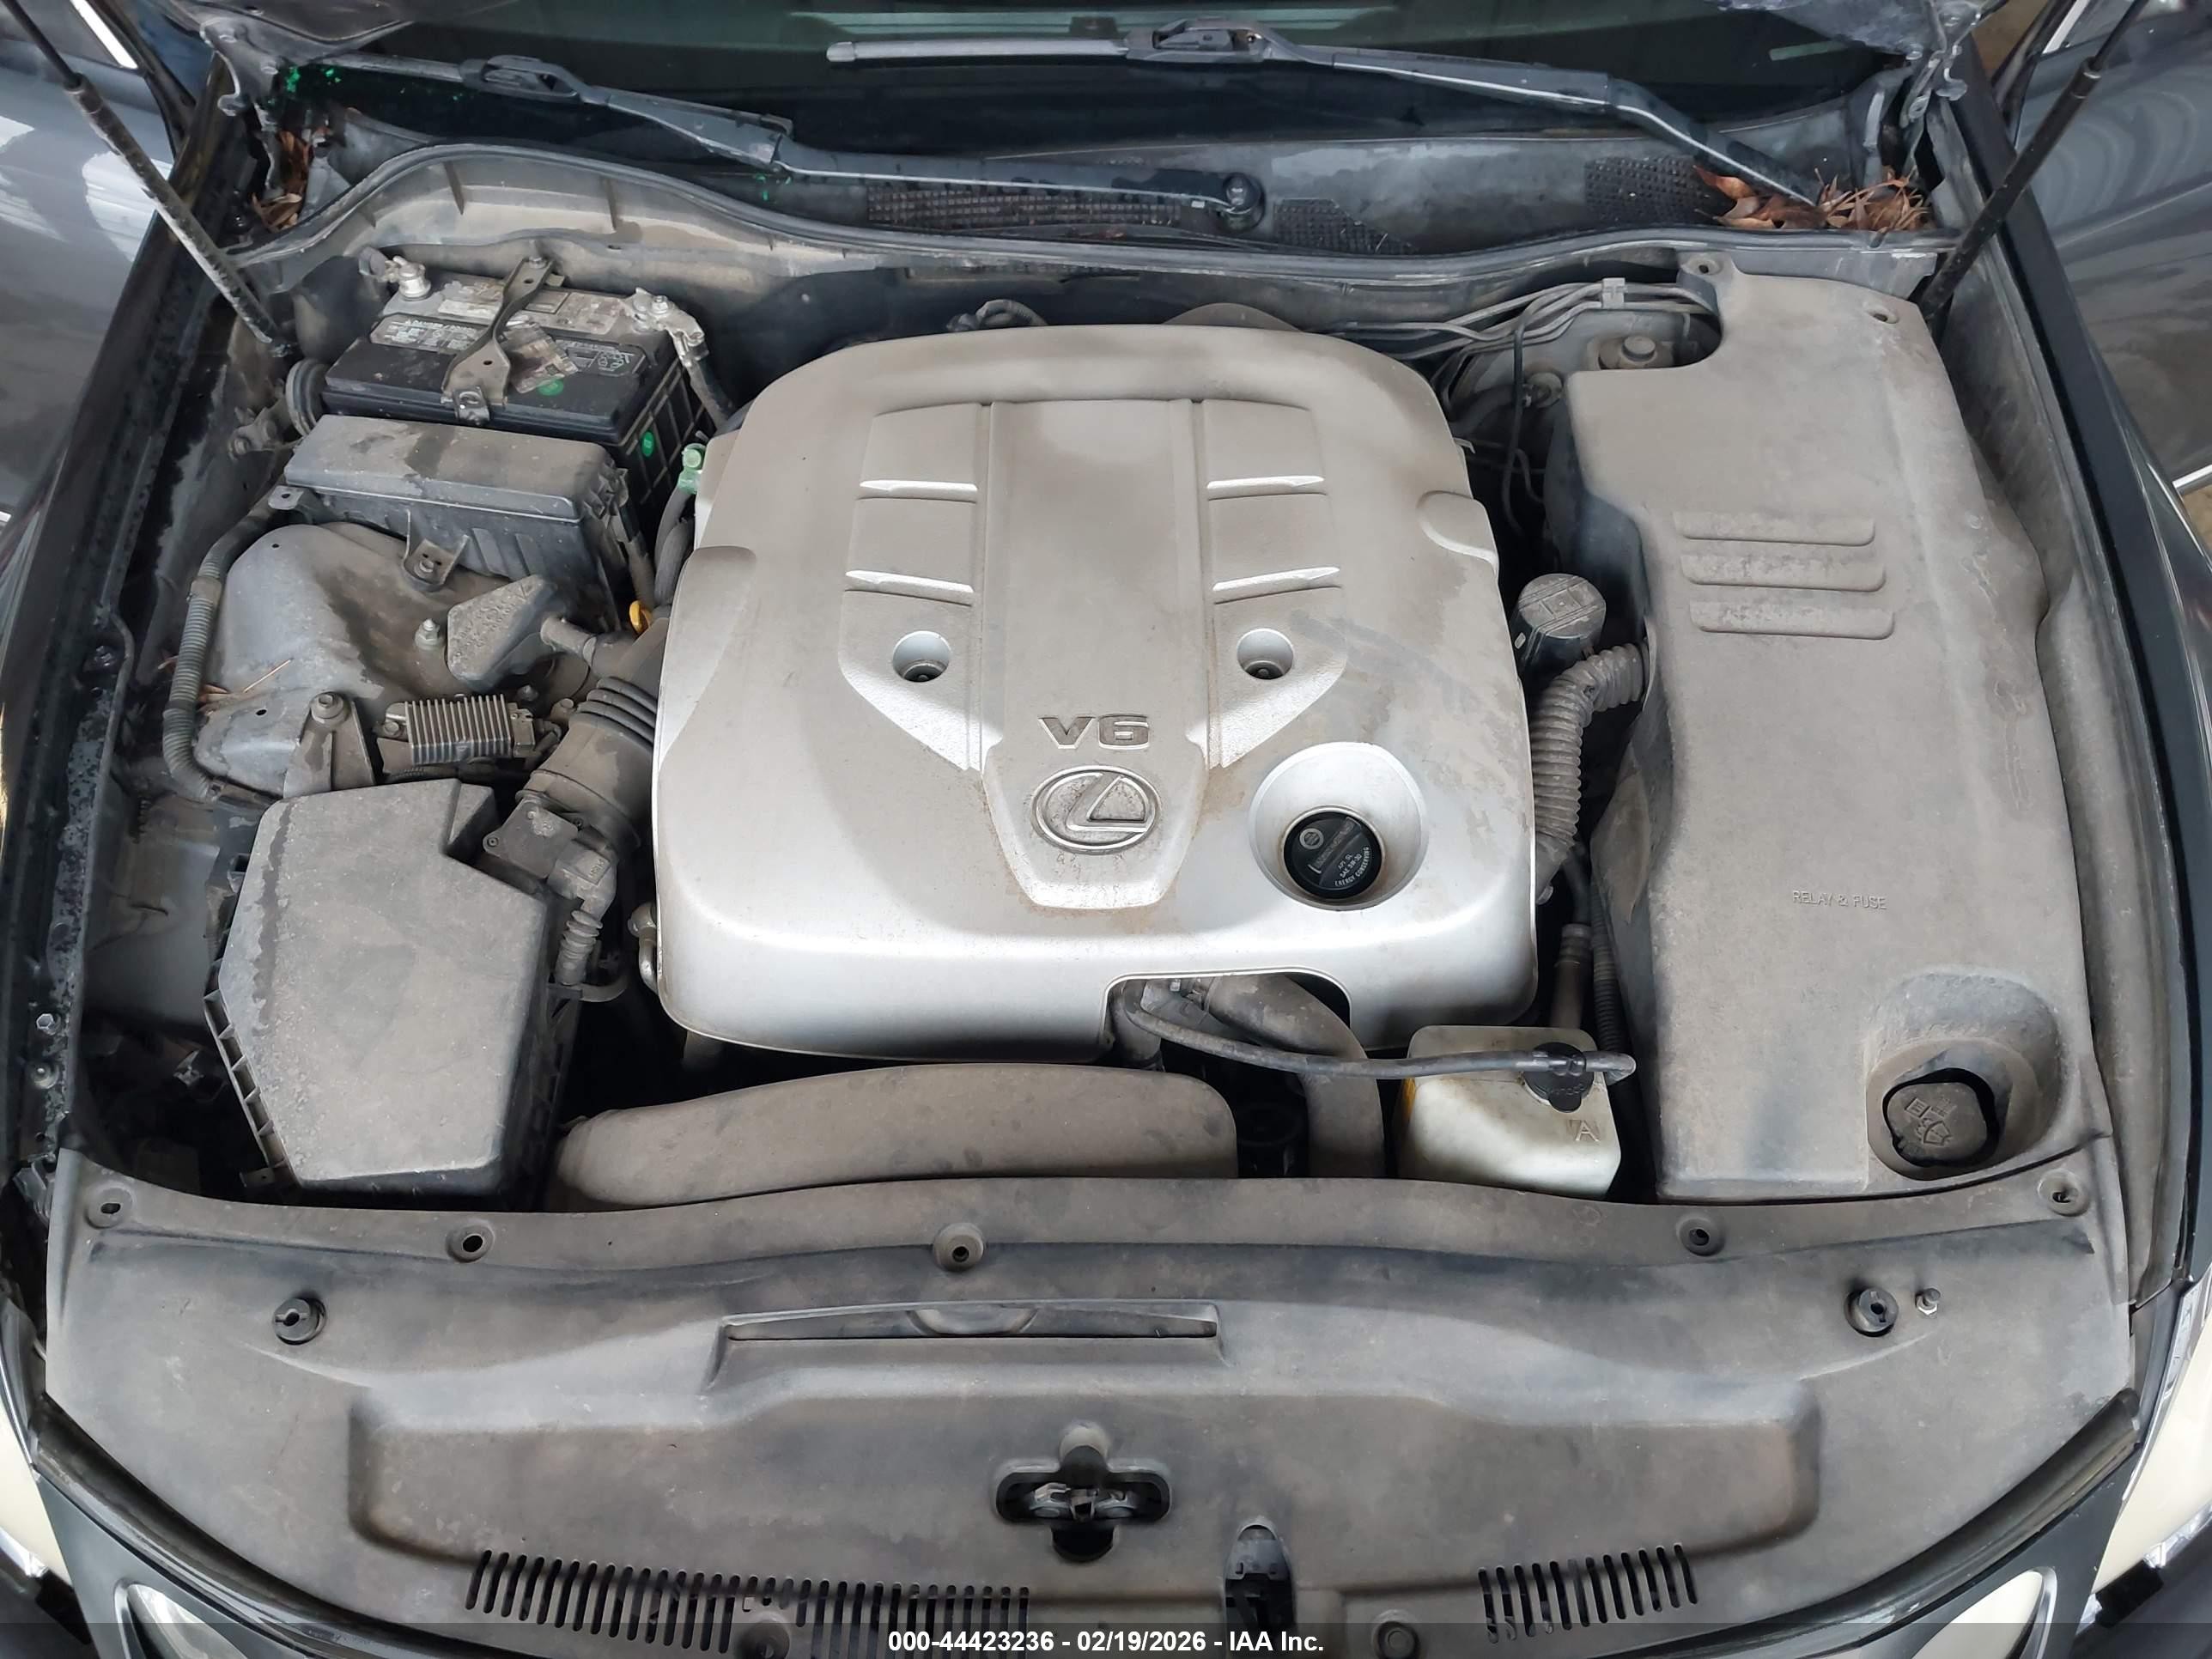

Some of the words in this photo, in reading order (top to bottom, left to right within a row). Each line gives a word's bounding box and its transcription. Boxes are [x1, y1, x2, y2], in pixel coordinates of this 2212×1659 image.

[1037, 713, 1150, 750] V6
[1792, 890, 1833, 907] RELAY
[1838, 894, 1849, 907] &
[1853, 895, 1887, 910] FUSE
